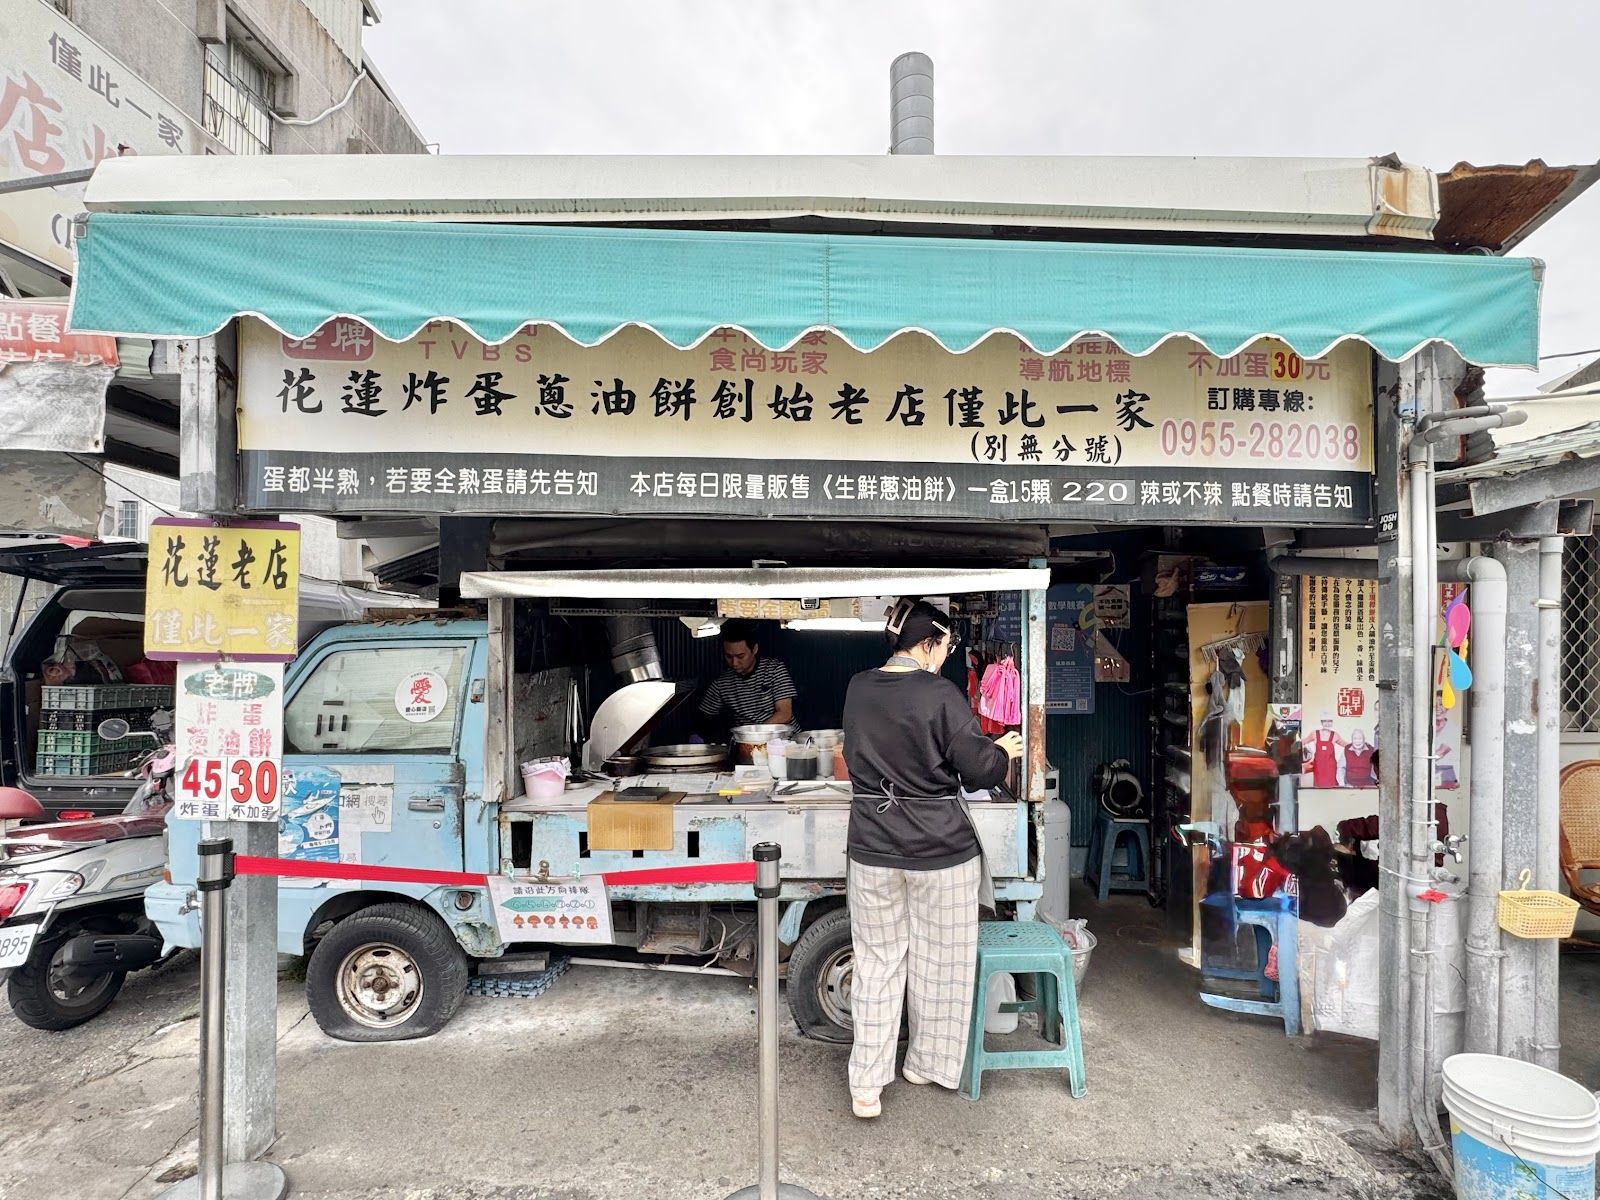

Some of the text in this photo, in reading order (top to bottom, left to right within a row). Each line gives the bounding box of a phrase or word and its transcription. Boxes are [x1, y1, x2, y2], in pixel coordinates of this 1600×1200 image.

[48, 31, 184, 154] 僅此一家
[709, 347, 828, 374] 食尚玩家
[1019, 358, 1131, 383] 導航地標
[971, 433, 1122, 465] (別無分號)
[1161, 419, 1359, 461] 0955-282038
[262, 466, 599, 496] 蛋都半熟，若要全熟蛋請先告知
[1231, 482, 1353, 509] 點餐時請告知
[1380, 512, 1397, 524] JOSH
[161, 535, 288, 590] 花蓮老店
[152, 609, 296, 649] 僅此一家
[182, 759, 278, 804] 45 30
[180, 802, 220, 818] 炸蛋
